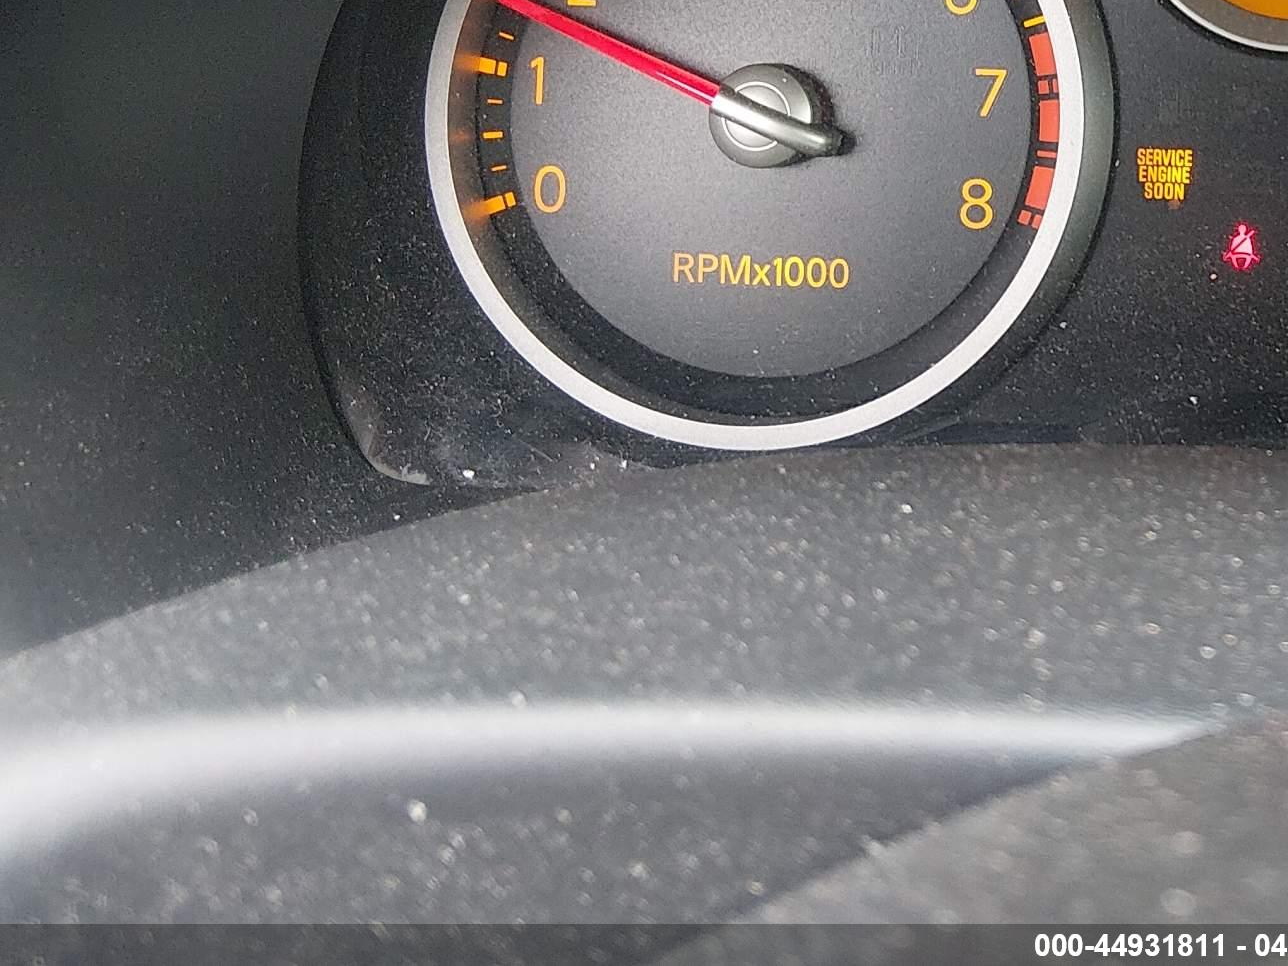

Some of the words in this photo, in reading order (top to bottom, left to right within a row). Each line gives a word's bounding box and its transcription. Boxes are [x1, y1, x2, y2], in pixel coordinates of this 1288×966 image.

[528, 56, 545, 104] 1
[975, 67, 1008, 116] 7
[1136, 147, 1193, 166] SERVICE
[1138, 165, 1191, 184] ENGINE
[532, 164, 567, 212] 0
[958, 177, 994, 229] 8
[1144, 182, 1185, 200] SOON
[673, 252, 850, 289] RPMx1000
